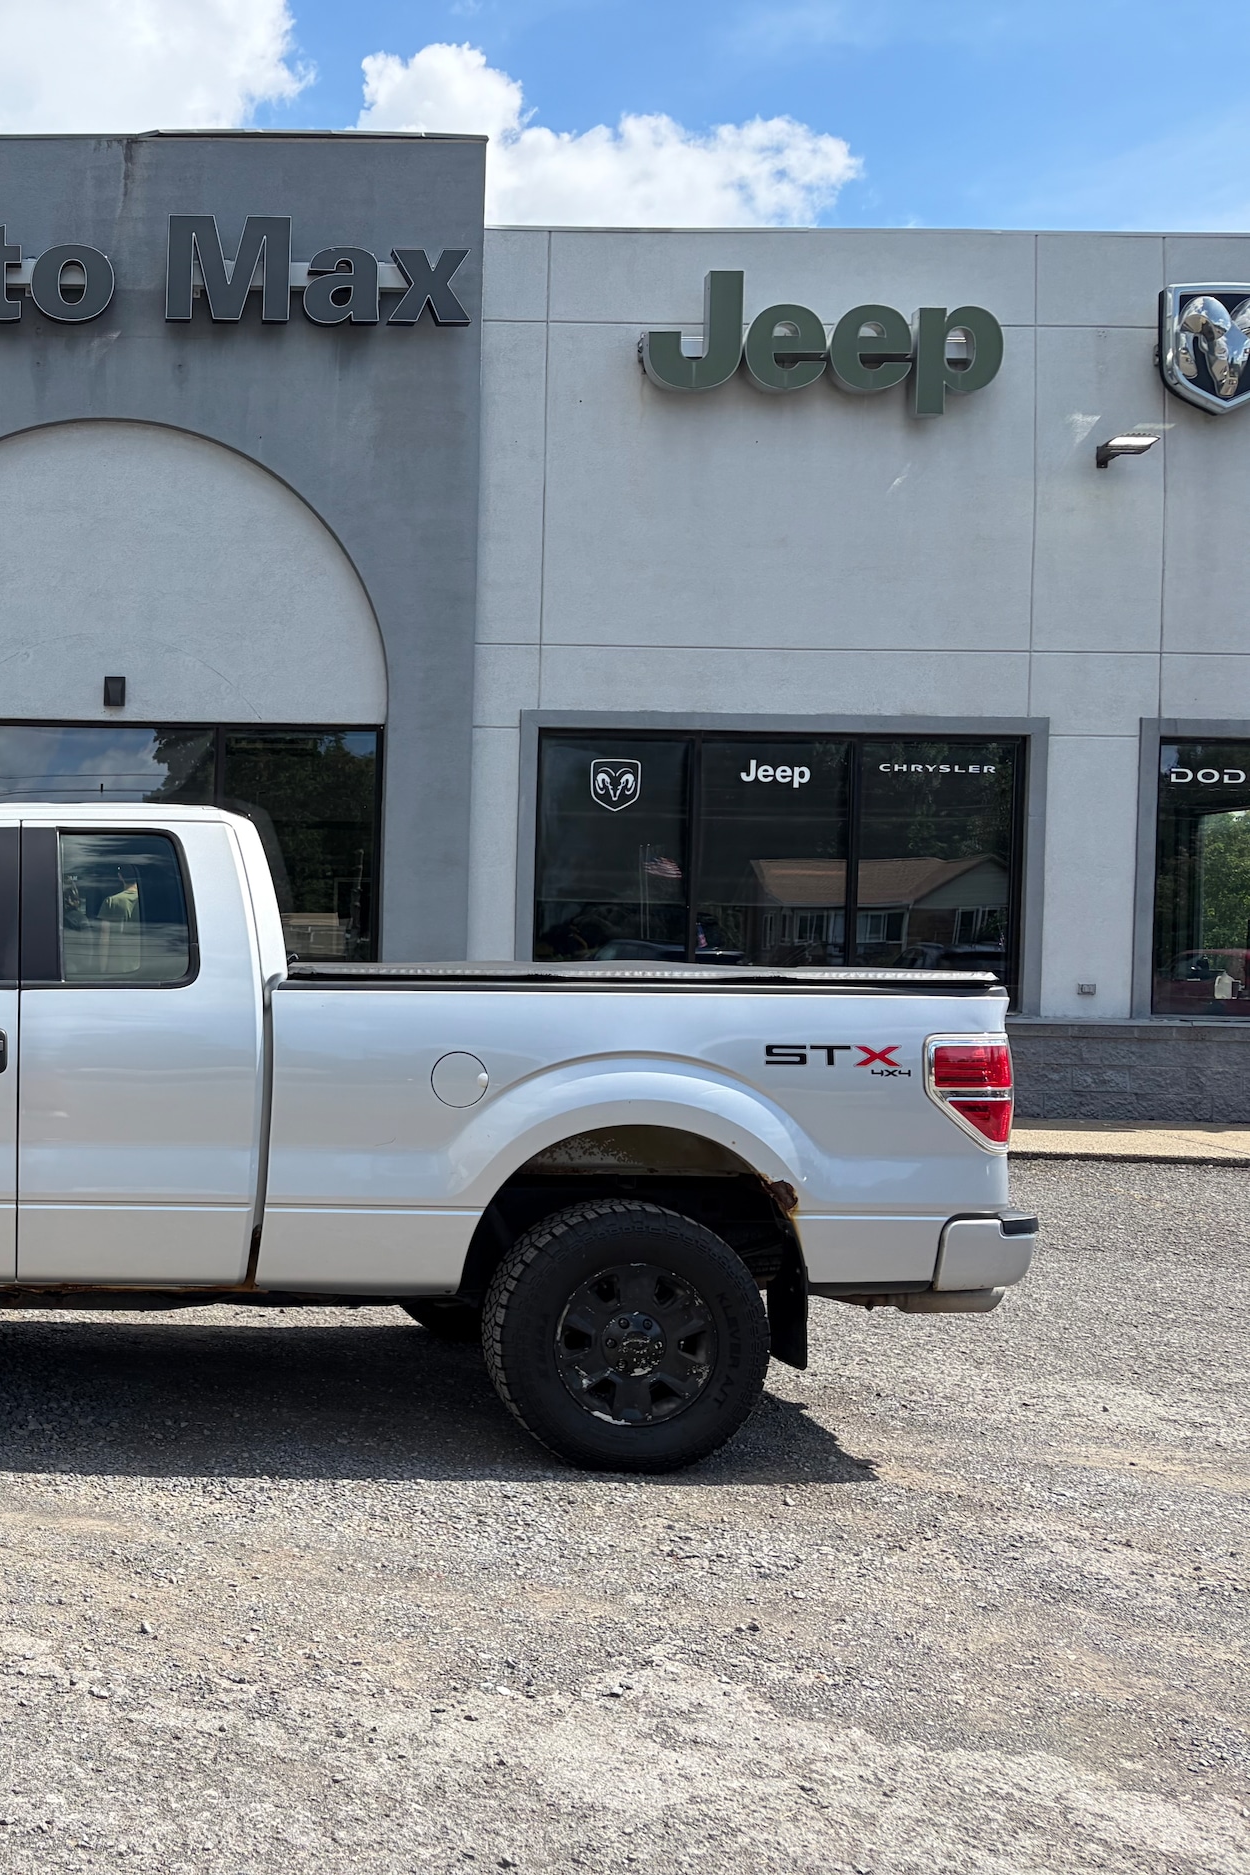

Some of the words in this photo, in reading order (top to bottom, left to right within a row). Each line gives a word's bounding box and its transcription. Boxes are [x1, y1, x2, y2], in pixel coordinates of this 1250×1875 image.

[165, 213, 473, 327] Max
[640, 270, 1005, 419] Jeep
[740, 759, 811, 788] Jeep
[878, 763, 996, 774] CHRYSLER
[764, 1044, 902, 1067] STX
